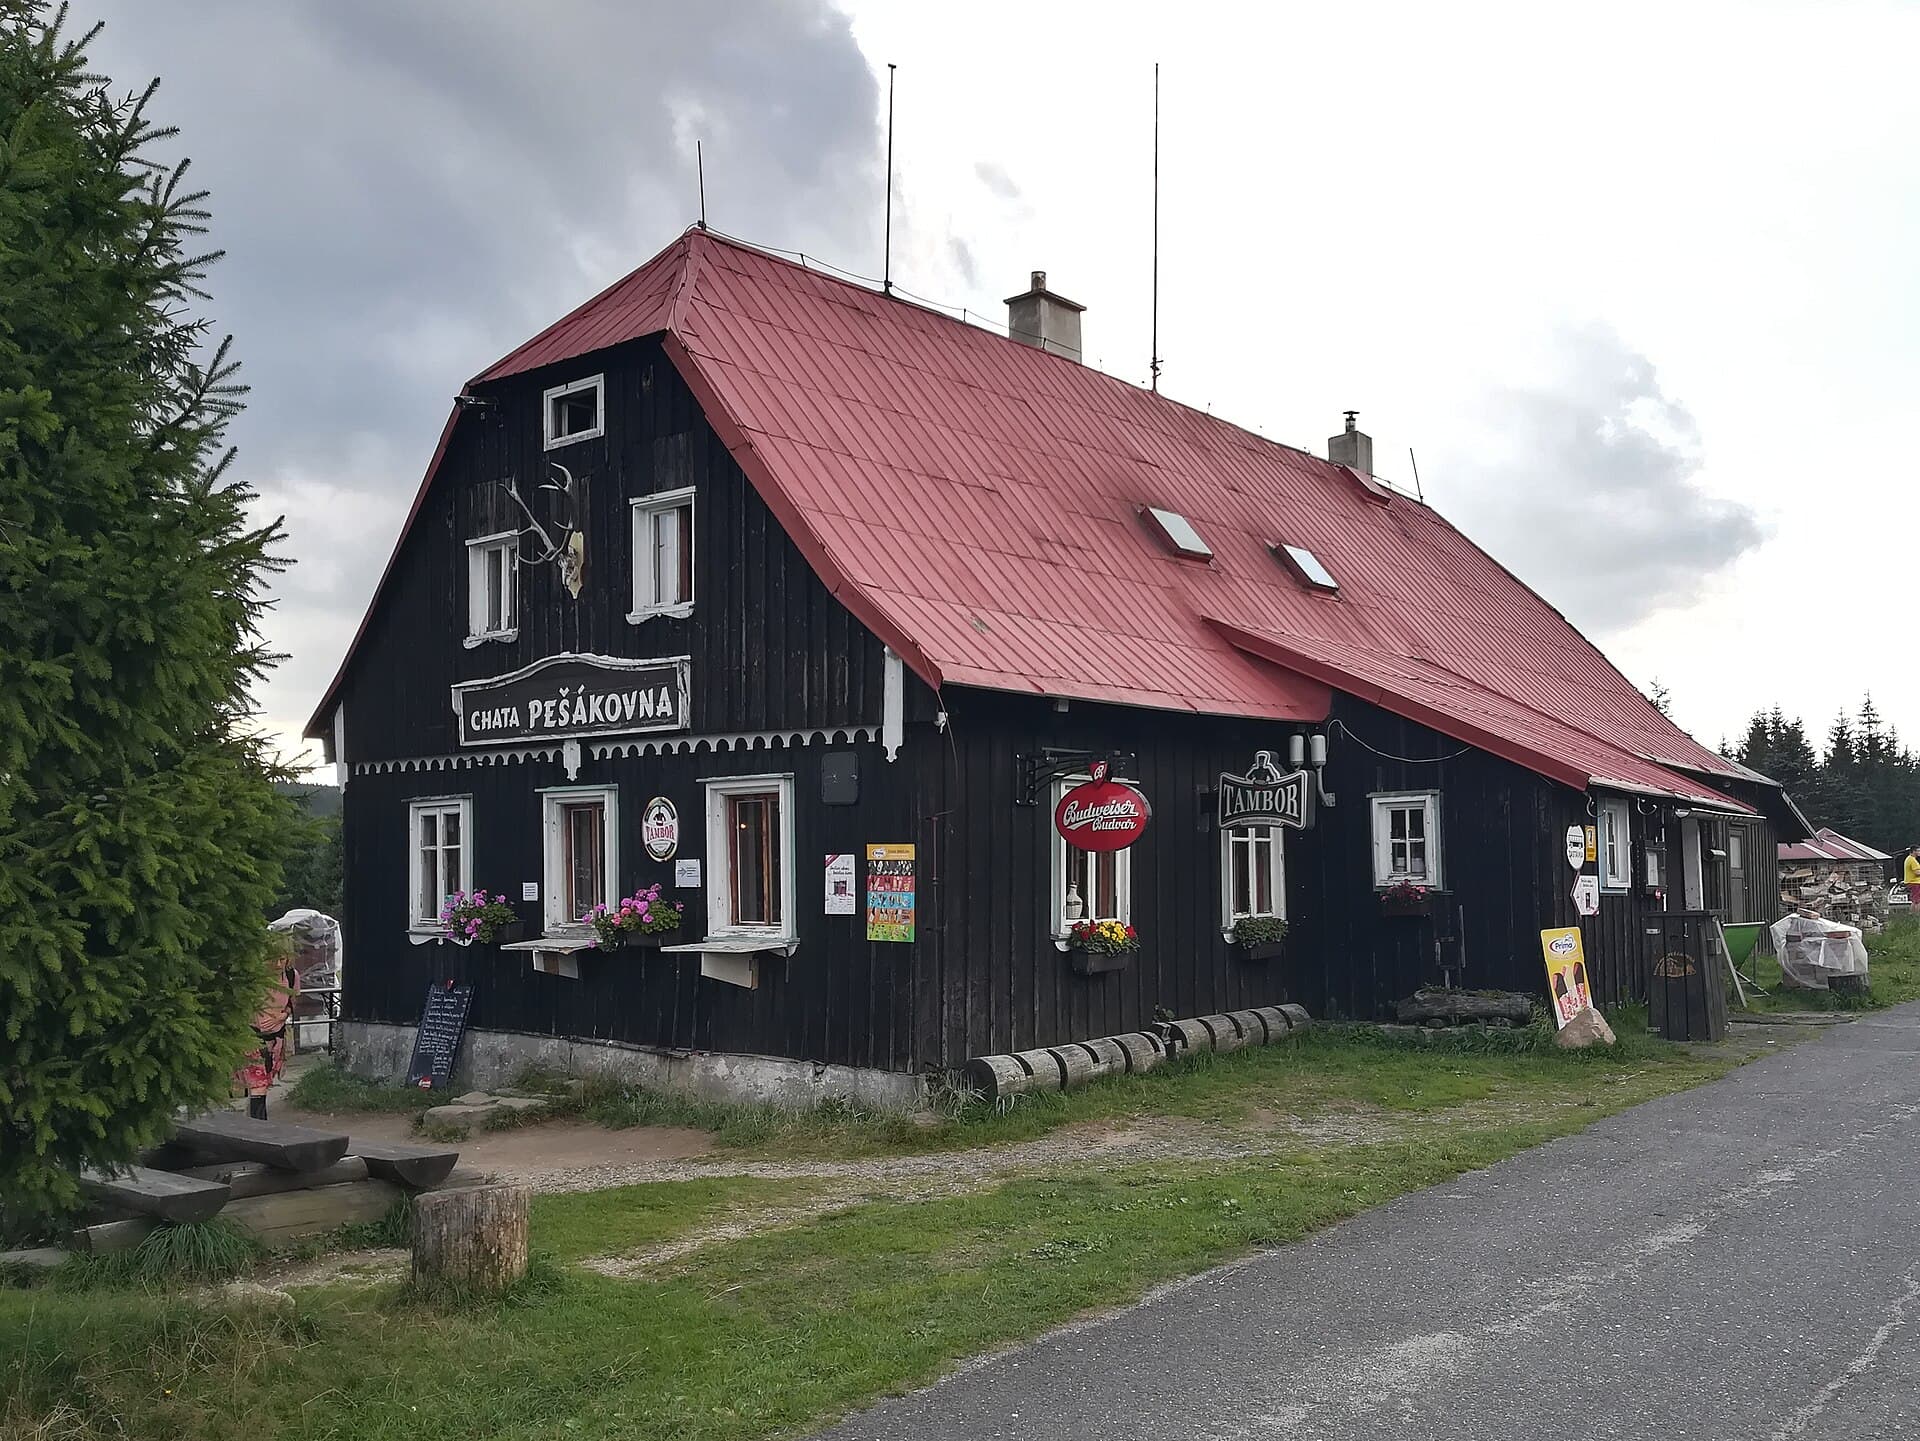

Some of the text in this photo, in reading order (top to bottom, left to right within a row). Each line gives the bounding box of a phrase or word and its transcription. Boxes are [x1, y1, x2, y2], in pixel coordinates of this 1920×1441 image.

[470, 684, 673, 732] CHATA PEŠÁKOVNA
[1063, 800, 1139, 827] Budweiser
[1223, 784, 1300, 817] TAMBOR
[645, 825, 674, 841] TAMBOR
[1092, 816, 1137, 832] Budvar
